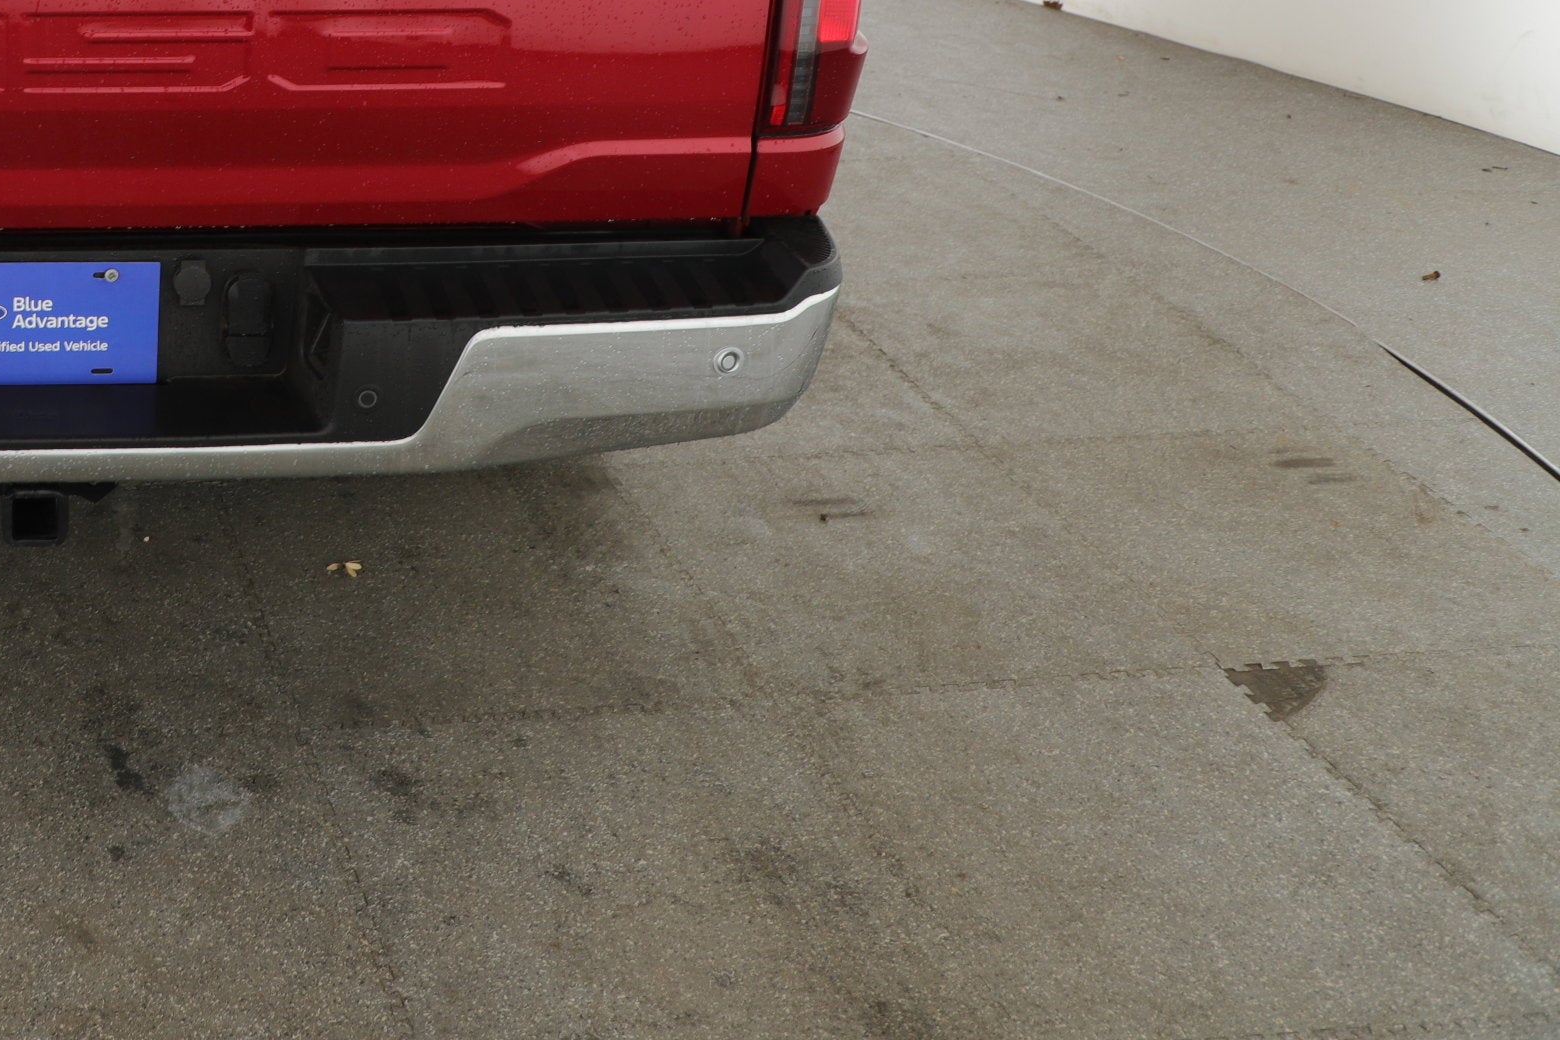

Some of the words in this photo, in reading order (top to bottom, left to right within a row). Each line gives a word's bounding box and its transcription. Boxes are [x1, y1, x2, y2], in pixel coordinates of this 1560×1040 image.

[12, 296, 53, 312] Blue
[12, 313, 109, 331] Advantage
[28, 341, 60, 352] Used
[64, 340, 109, 352] Vehicle
